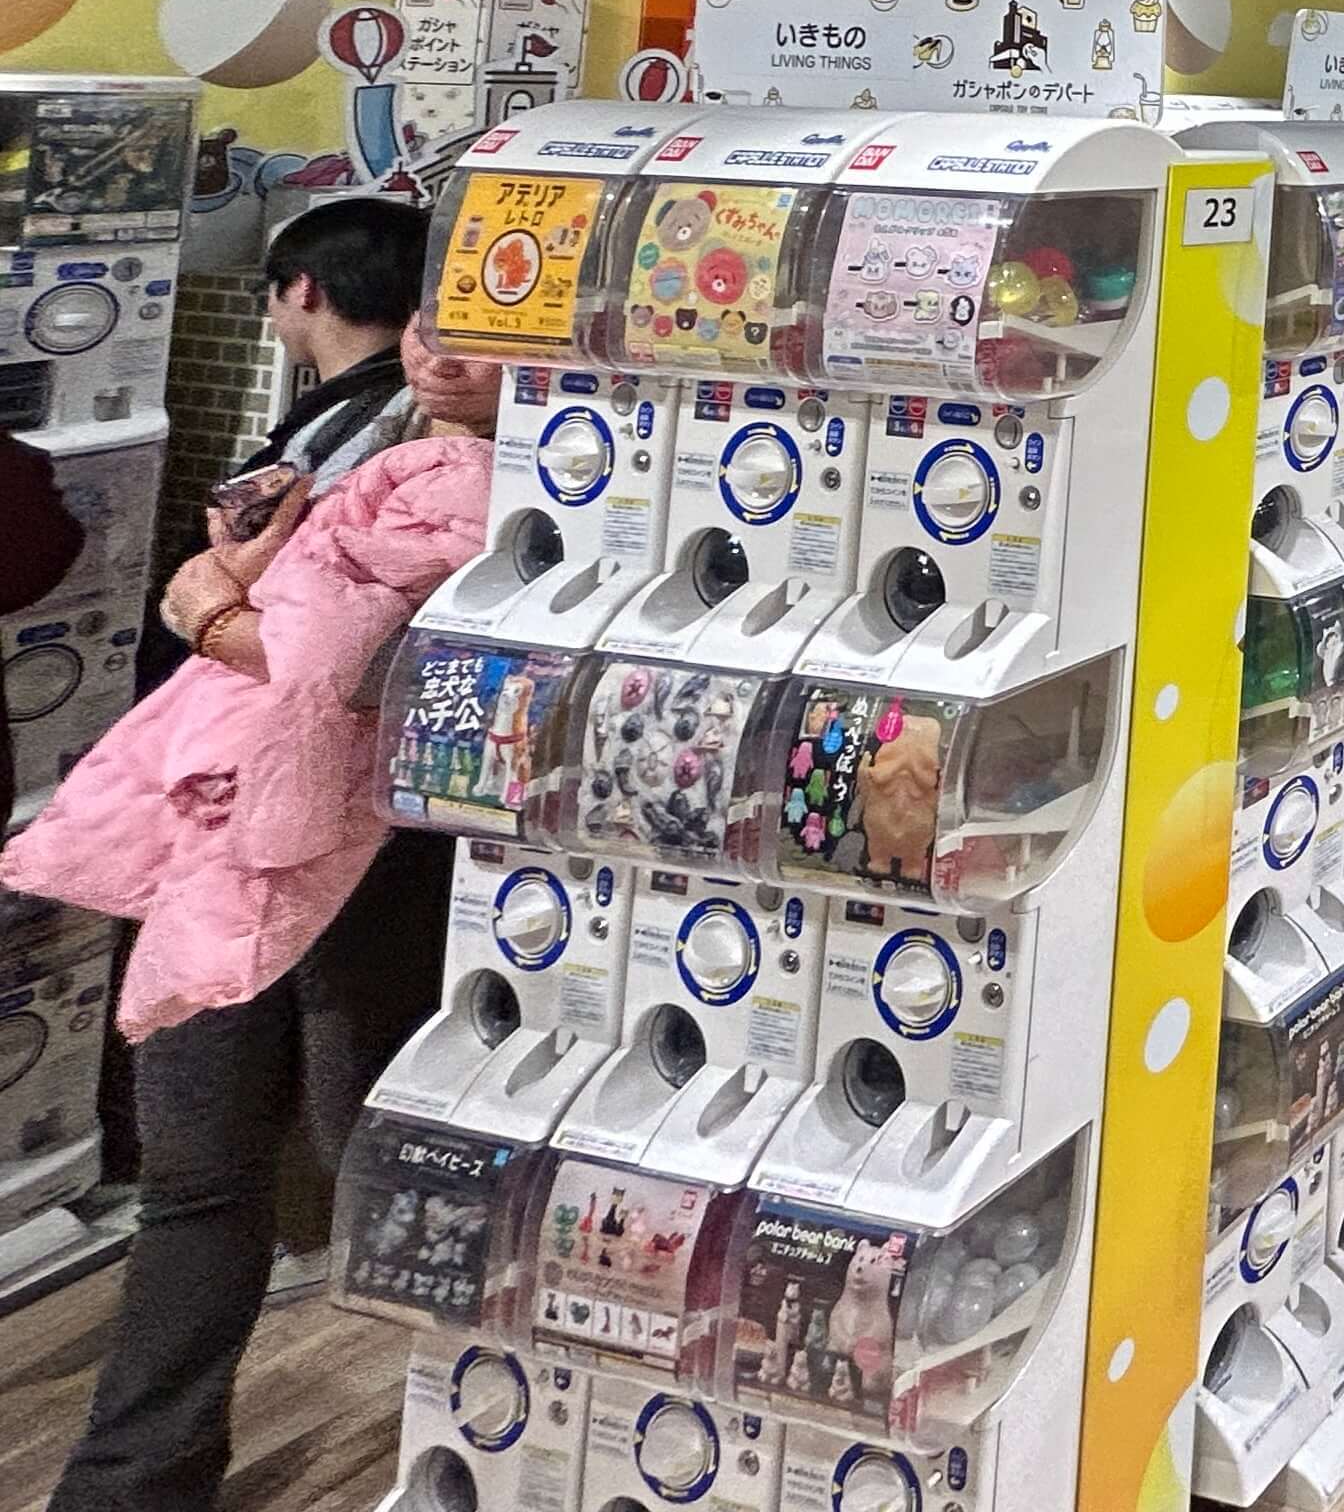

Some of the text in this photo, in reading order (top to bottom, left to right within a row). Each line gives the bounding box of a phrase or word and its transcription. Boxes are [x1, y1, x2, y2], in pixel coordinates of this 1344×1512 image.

[776, 22, 867, 49] いきもの
[771, 54, 872, 71] LIVING THINGS
[953, 80, 1095, 102] ガシャポンのデパート
[496, 182, 566, 208] アデリア
[504, 210, 544, 227] レトロ
[1203, 199, 1237, 227] 23
[421, 656, 485, 677] どこまでも
[403, 696, 485, 733] ハチ公
[756, 1219, 857, 1252] polar bear bank
